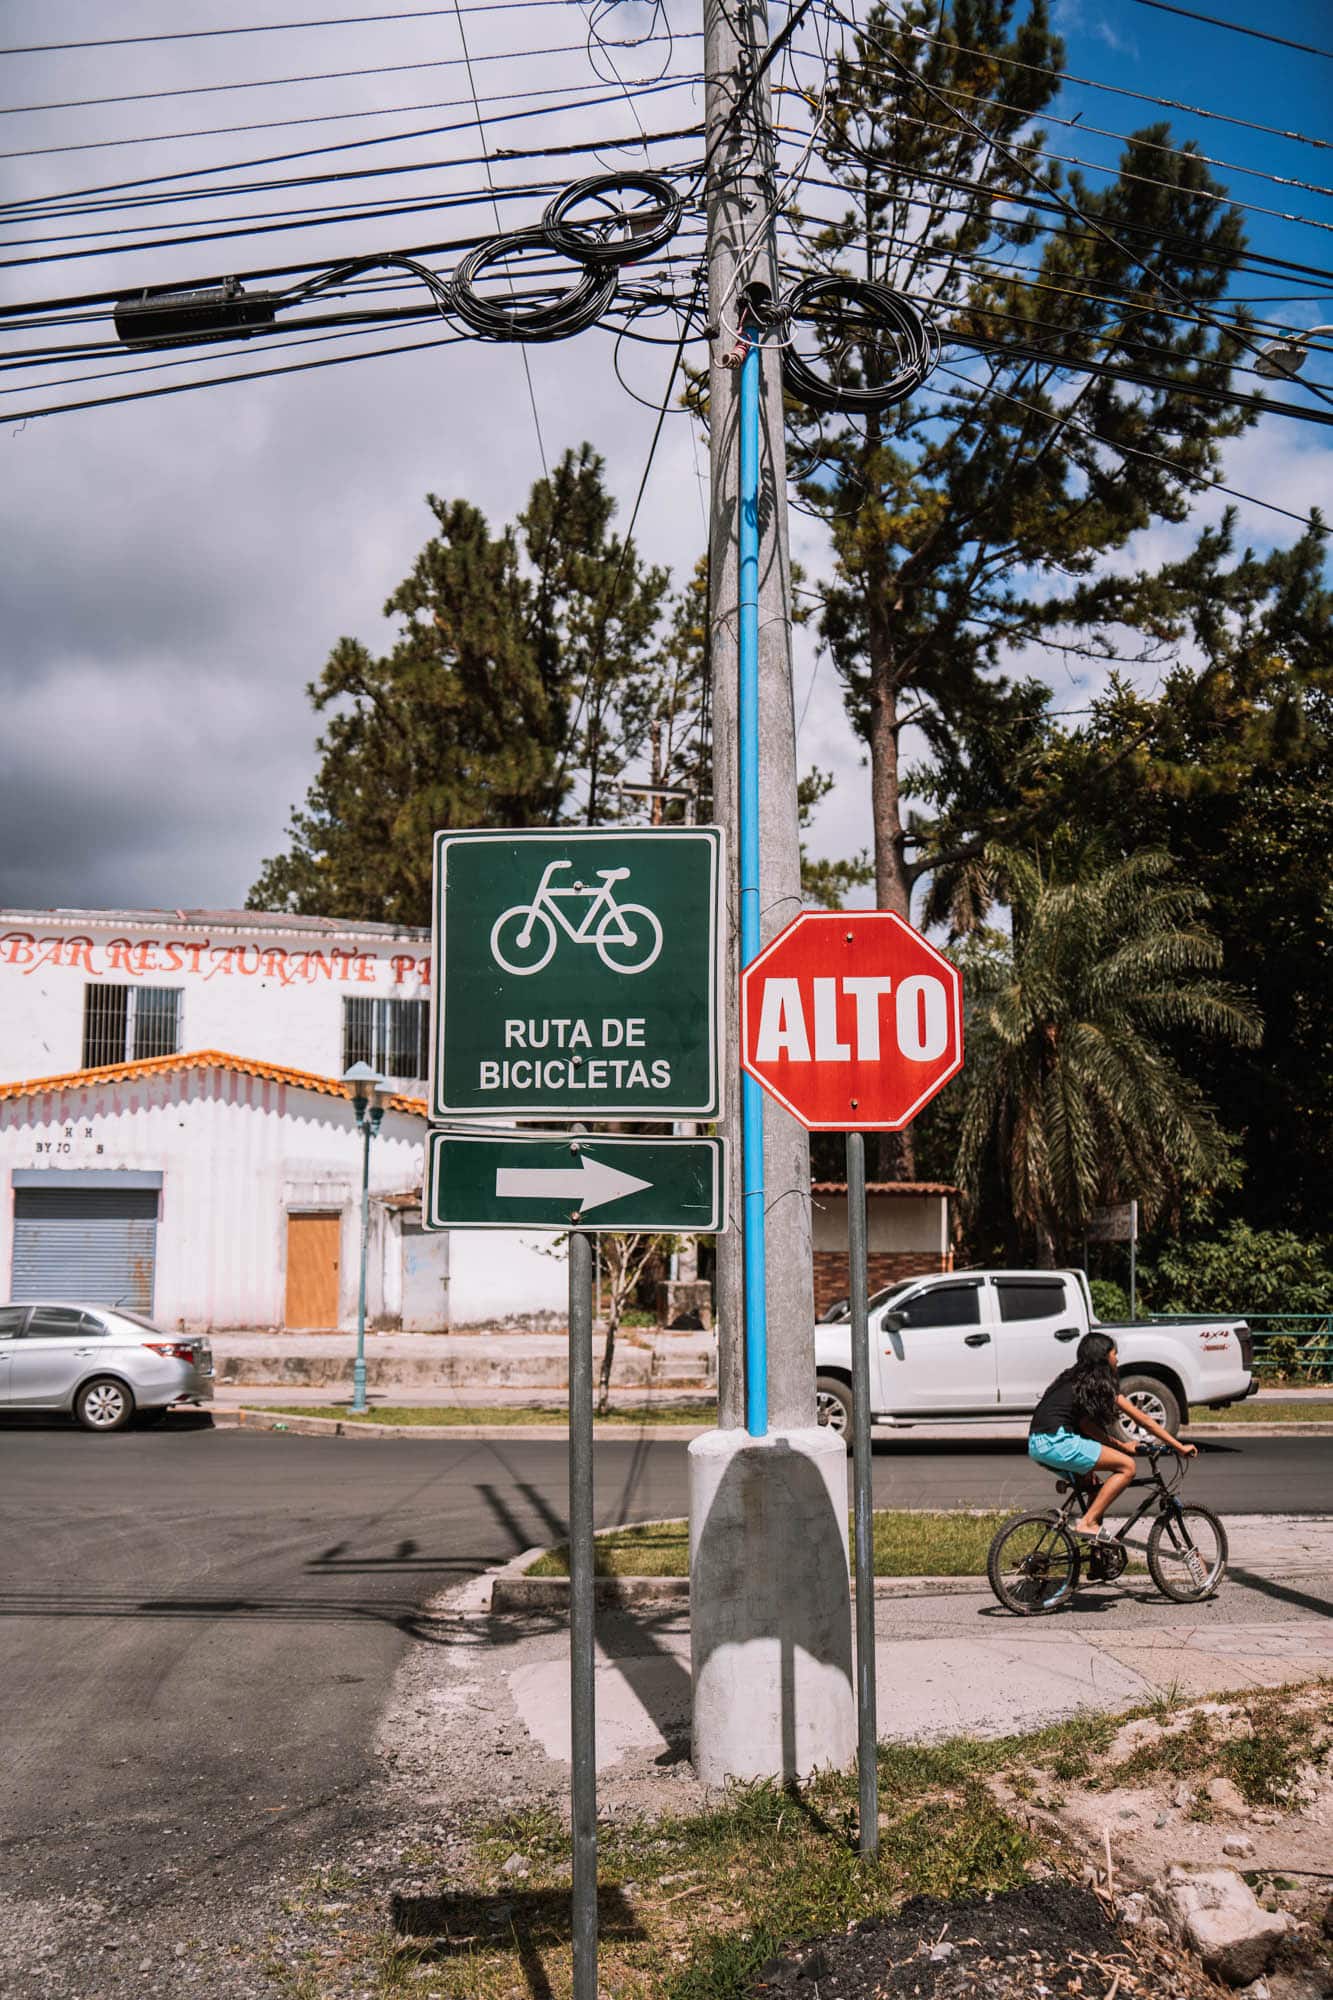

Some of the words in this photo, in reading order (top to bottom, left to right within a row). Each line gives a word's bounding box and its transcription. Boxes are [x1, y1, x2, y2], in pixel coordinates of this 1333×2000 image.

[0, 932, 103, 975] BAR
[105, 937, 377, 987] RESTAURANTE
[504, 1018, 591, 1048] RUTA
[601, 1018, 646, 1048] DE
[756, 975, 948, 1062] ALTO
[479, 1060, 671, 1090] BICICLETAS
